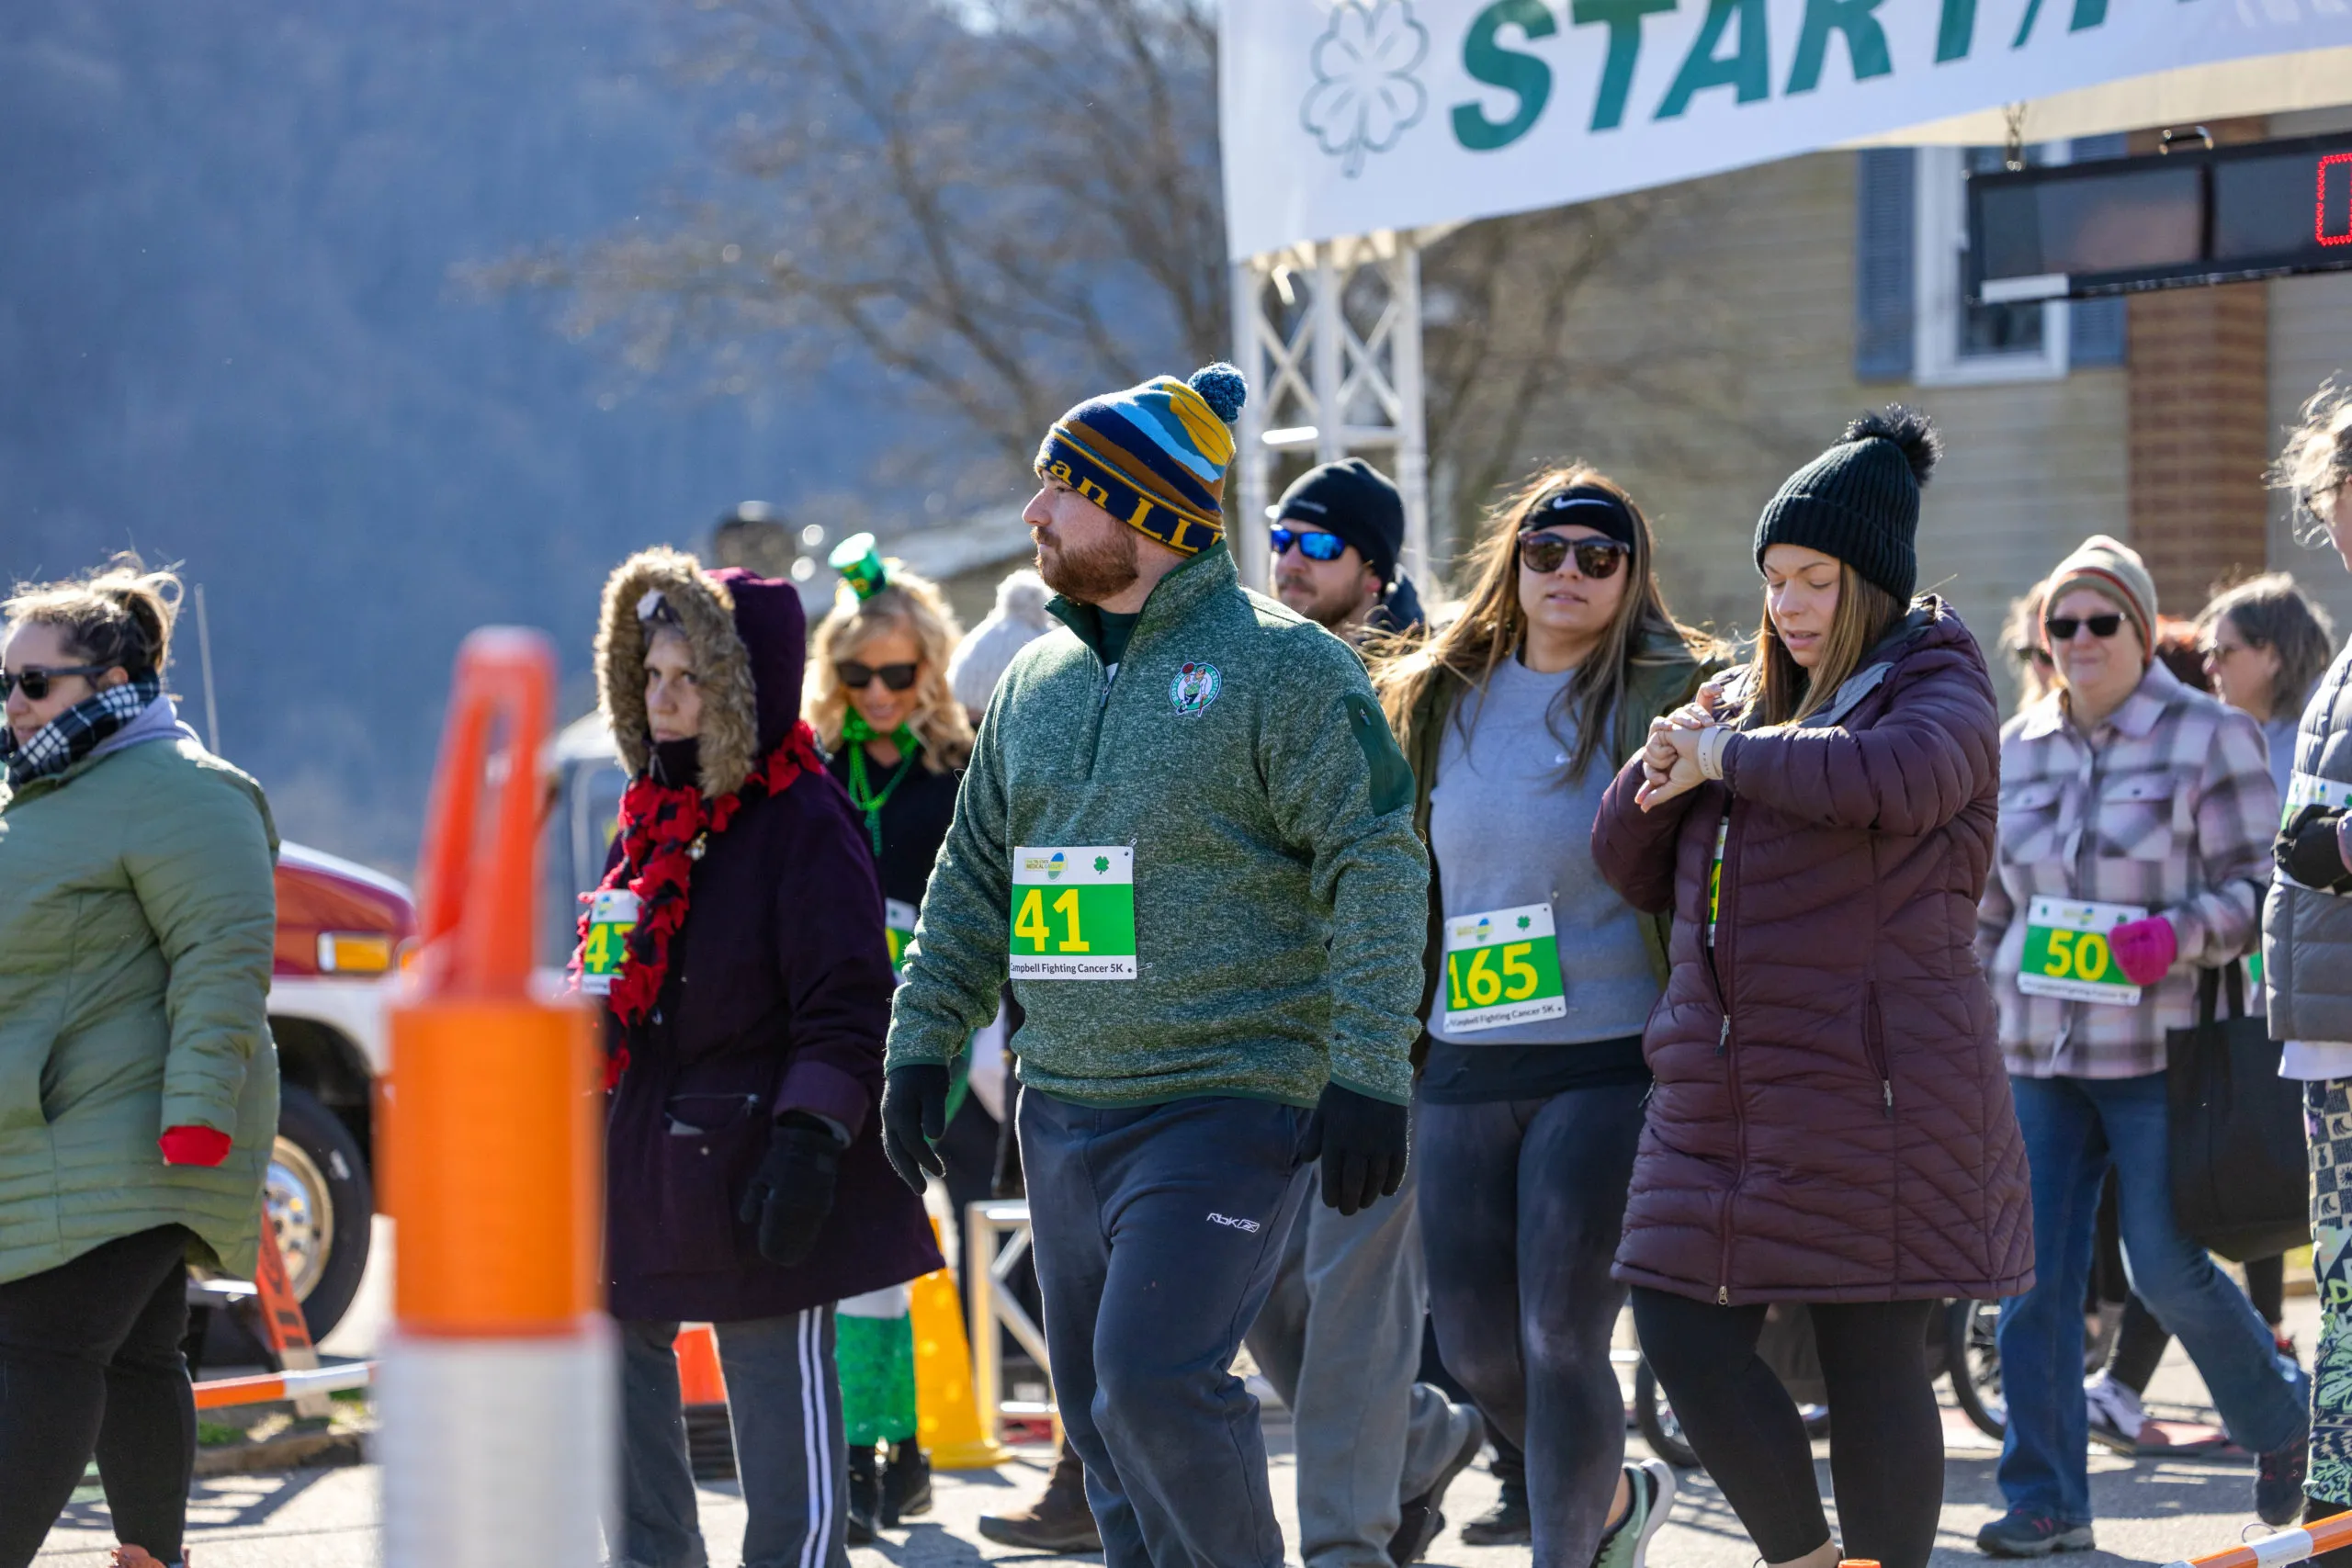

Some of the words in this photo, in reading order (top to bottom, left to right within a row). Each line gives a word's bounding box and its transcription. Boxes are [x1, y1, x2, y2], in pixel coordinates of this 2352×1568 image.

[1014, 888, 1091, 953] 41
[1041, 964, 1076, 975] Fighting
[1077, 964, 1108, 973] Cancer
[1110, 963, 1124, 973] 5K
[1448, 942, 1539, 1009] 165
[2043, 929, 2109, 982] 50
[1511, 1009, 1540, 1018] Cancer
